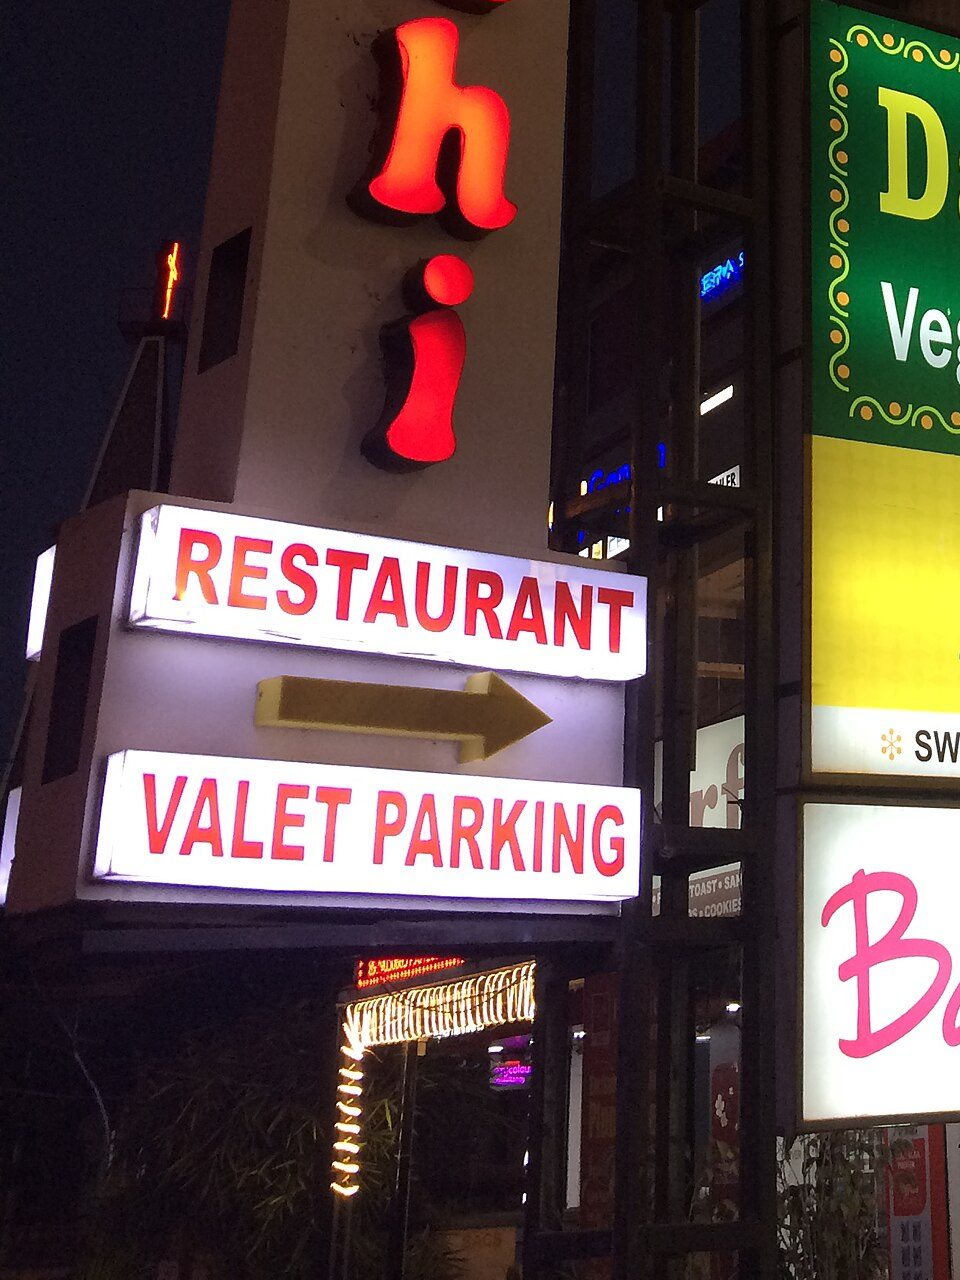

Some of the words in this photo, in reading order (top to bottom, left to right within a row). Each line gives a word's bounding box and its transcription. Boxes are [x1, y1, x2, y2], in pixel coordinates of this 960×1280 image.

[172, 527, 634, 654] RESTAURANT
[143, 773, 352, 863] VALET
[373, 790, 625, 877] PARKING
